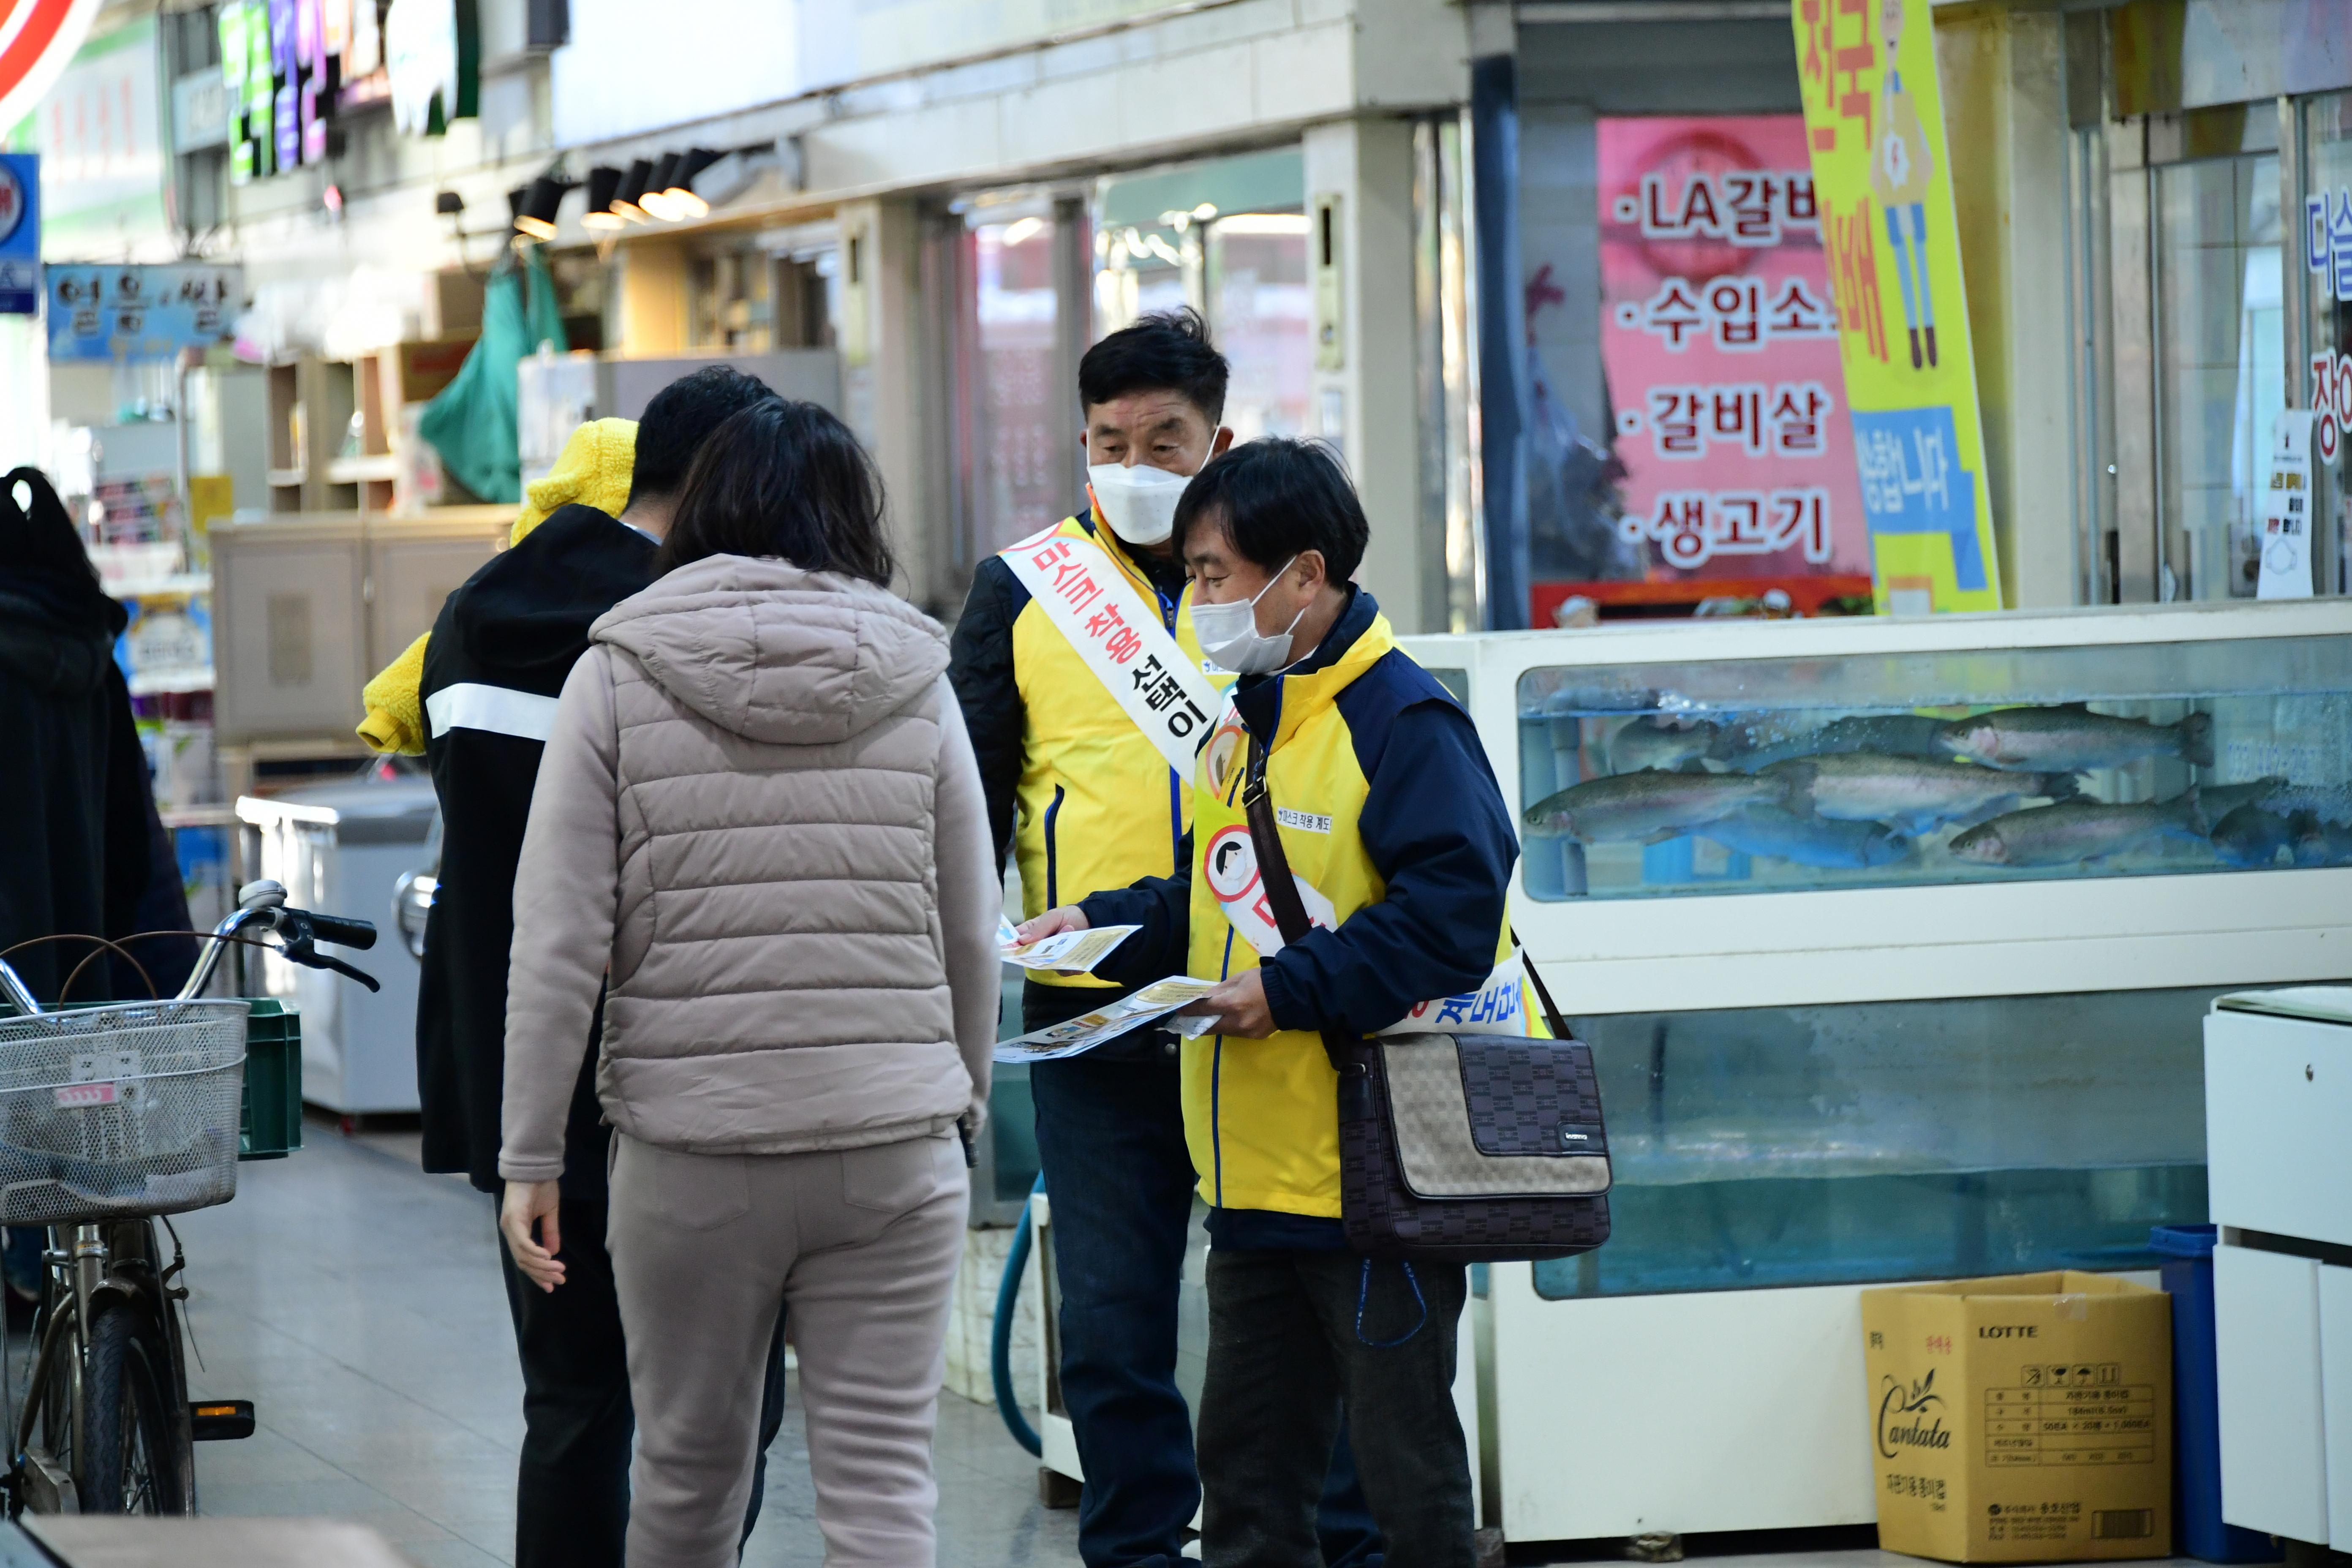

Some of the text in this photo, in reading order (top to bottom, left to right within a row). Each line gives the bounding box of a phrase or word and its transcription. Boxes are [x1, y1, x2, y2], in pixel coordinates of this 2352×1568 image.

[1650, 285, 1838, 344] 수입소
[1654, 389, 1824, 452] 갈비살
[1657, 495, 1821, 558] 생고기
[1032, 541, 1208, 738] 마스크 착용 선택이
[1283, 810, 1332, 831] 마스크 착용 계도
[1979, 1325, 2039, 1339] LOTTE
[1878, 1375, 1952, 1459] Cantata
